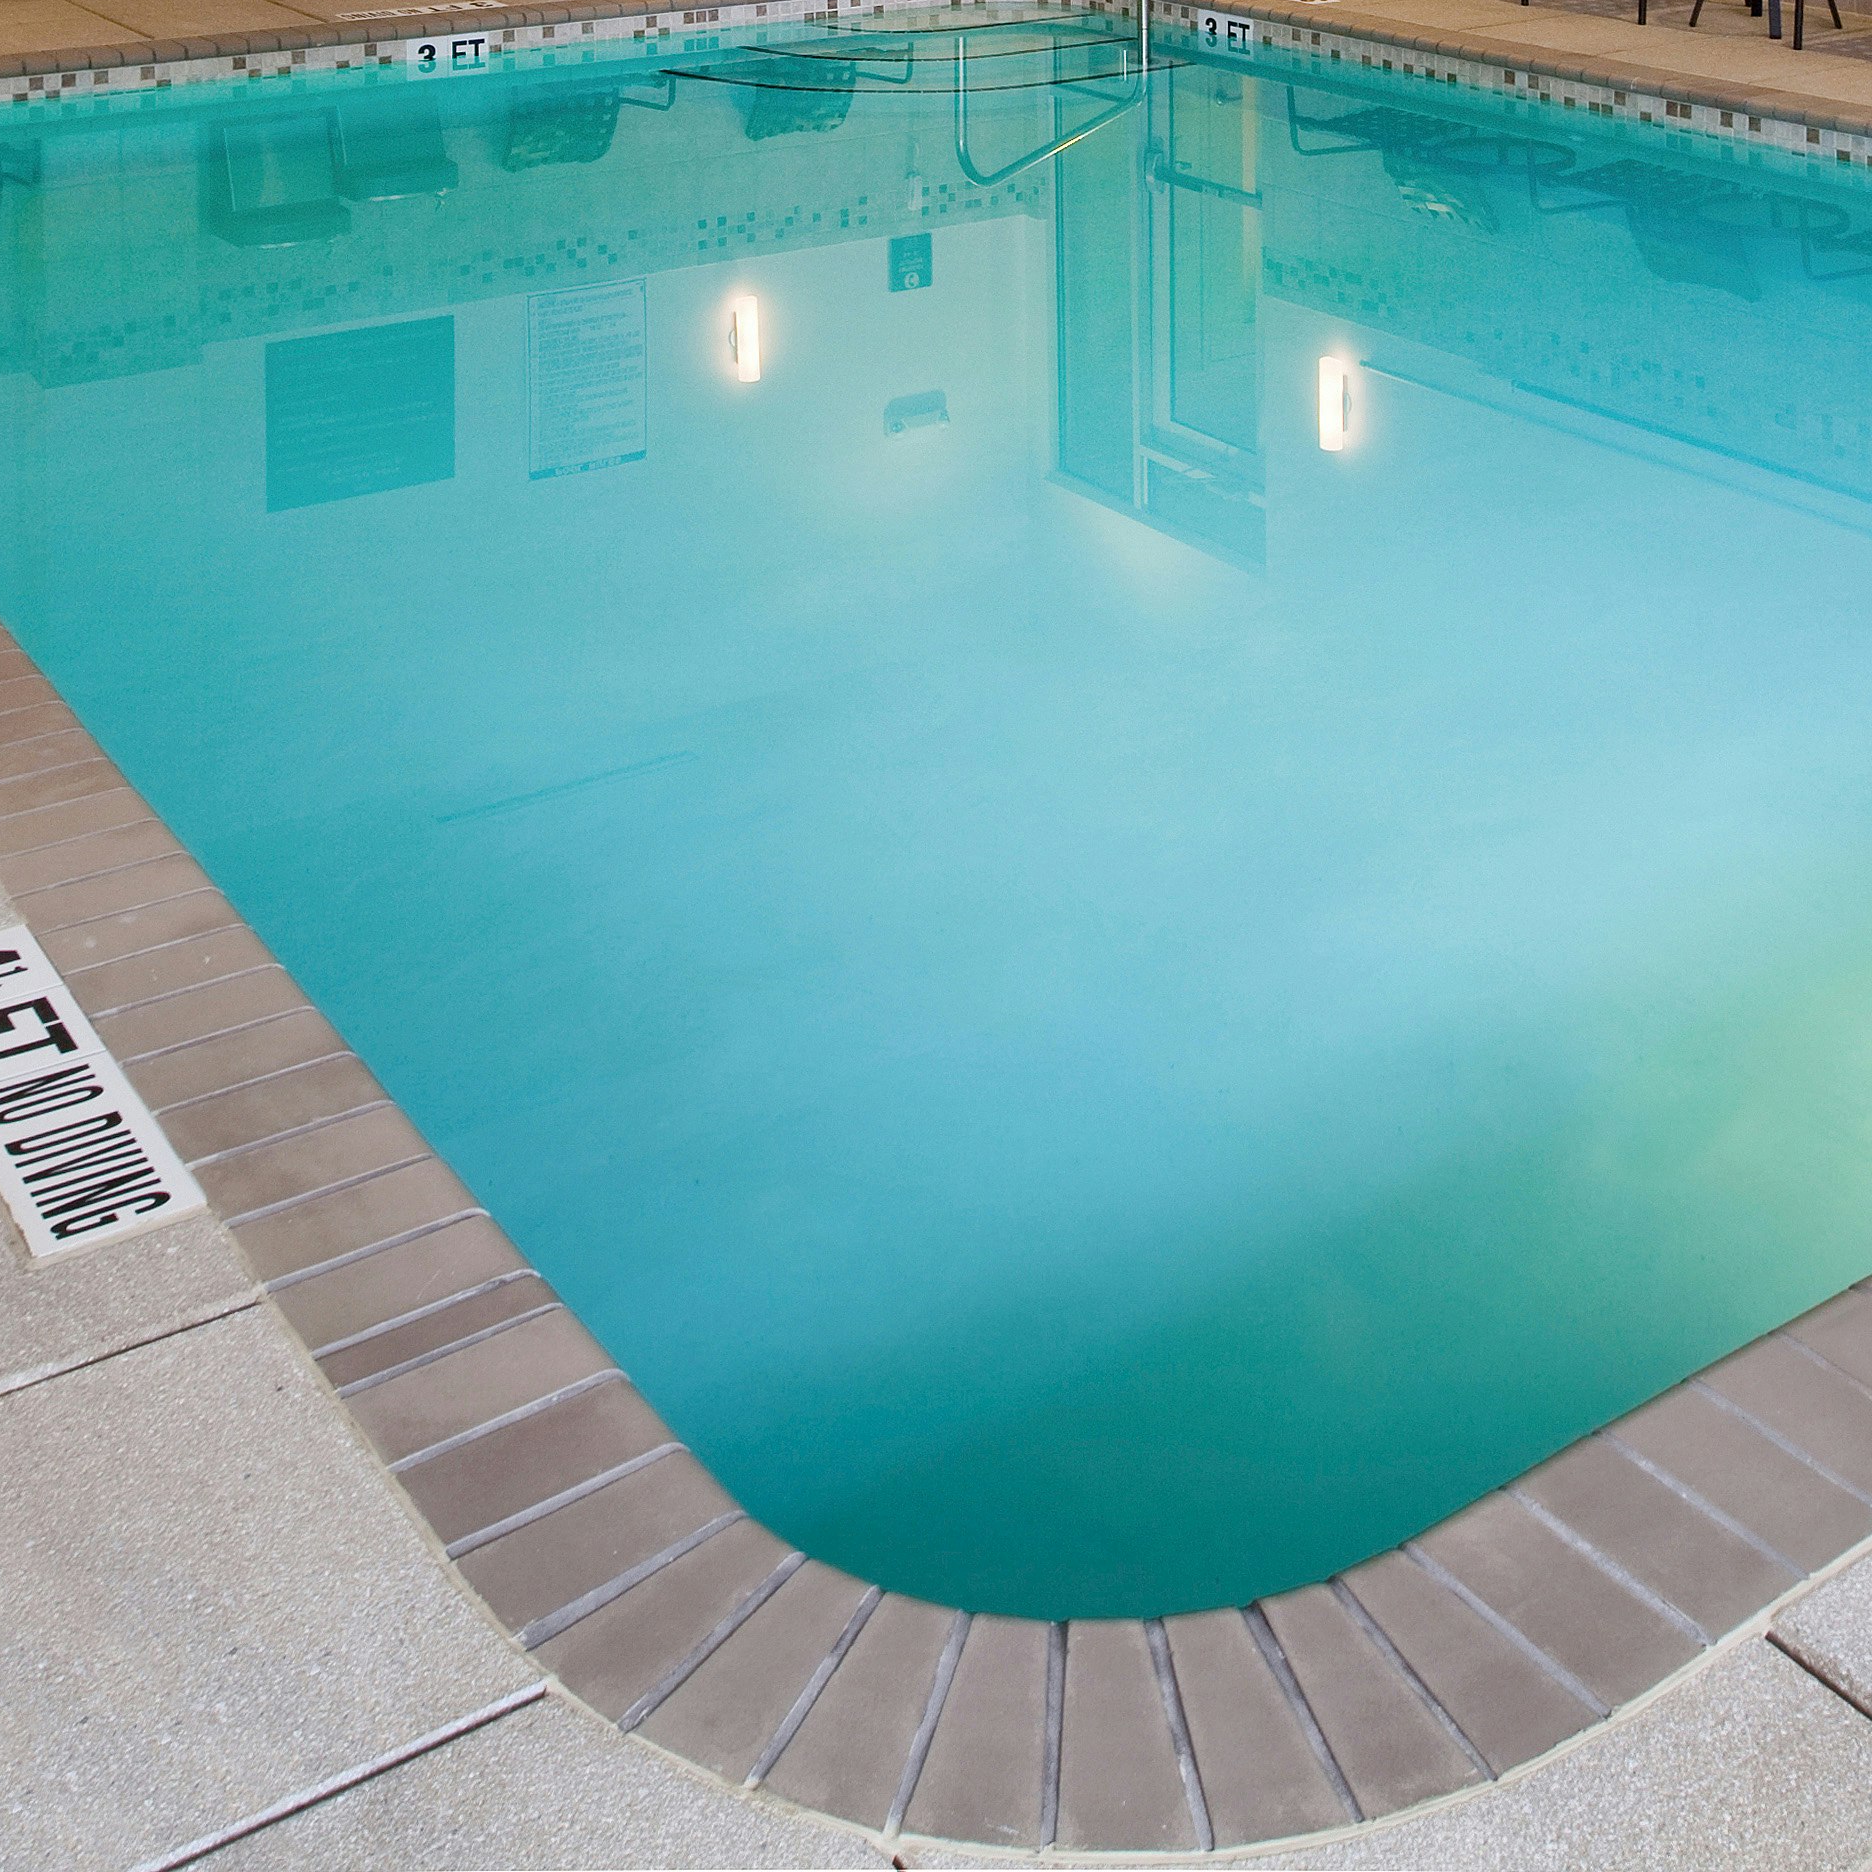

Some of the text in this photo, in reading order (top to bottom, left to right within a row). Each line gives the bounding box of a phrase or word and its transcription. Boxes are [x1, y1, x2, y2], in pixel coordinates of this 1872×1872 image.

[1205, 17, 1250, 42] 3 FT
[418, 38, 485, 61] 3 FT
[4, 1111, 171, 1240] DIVING
